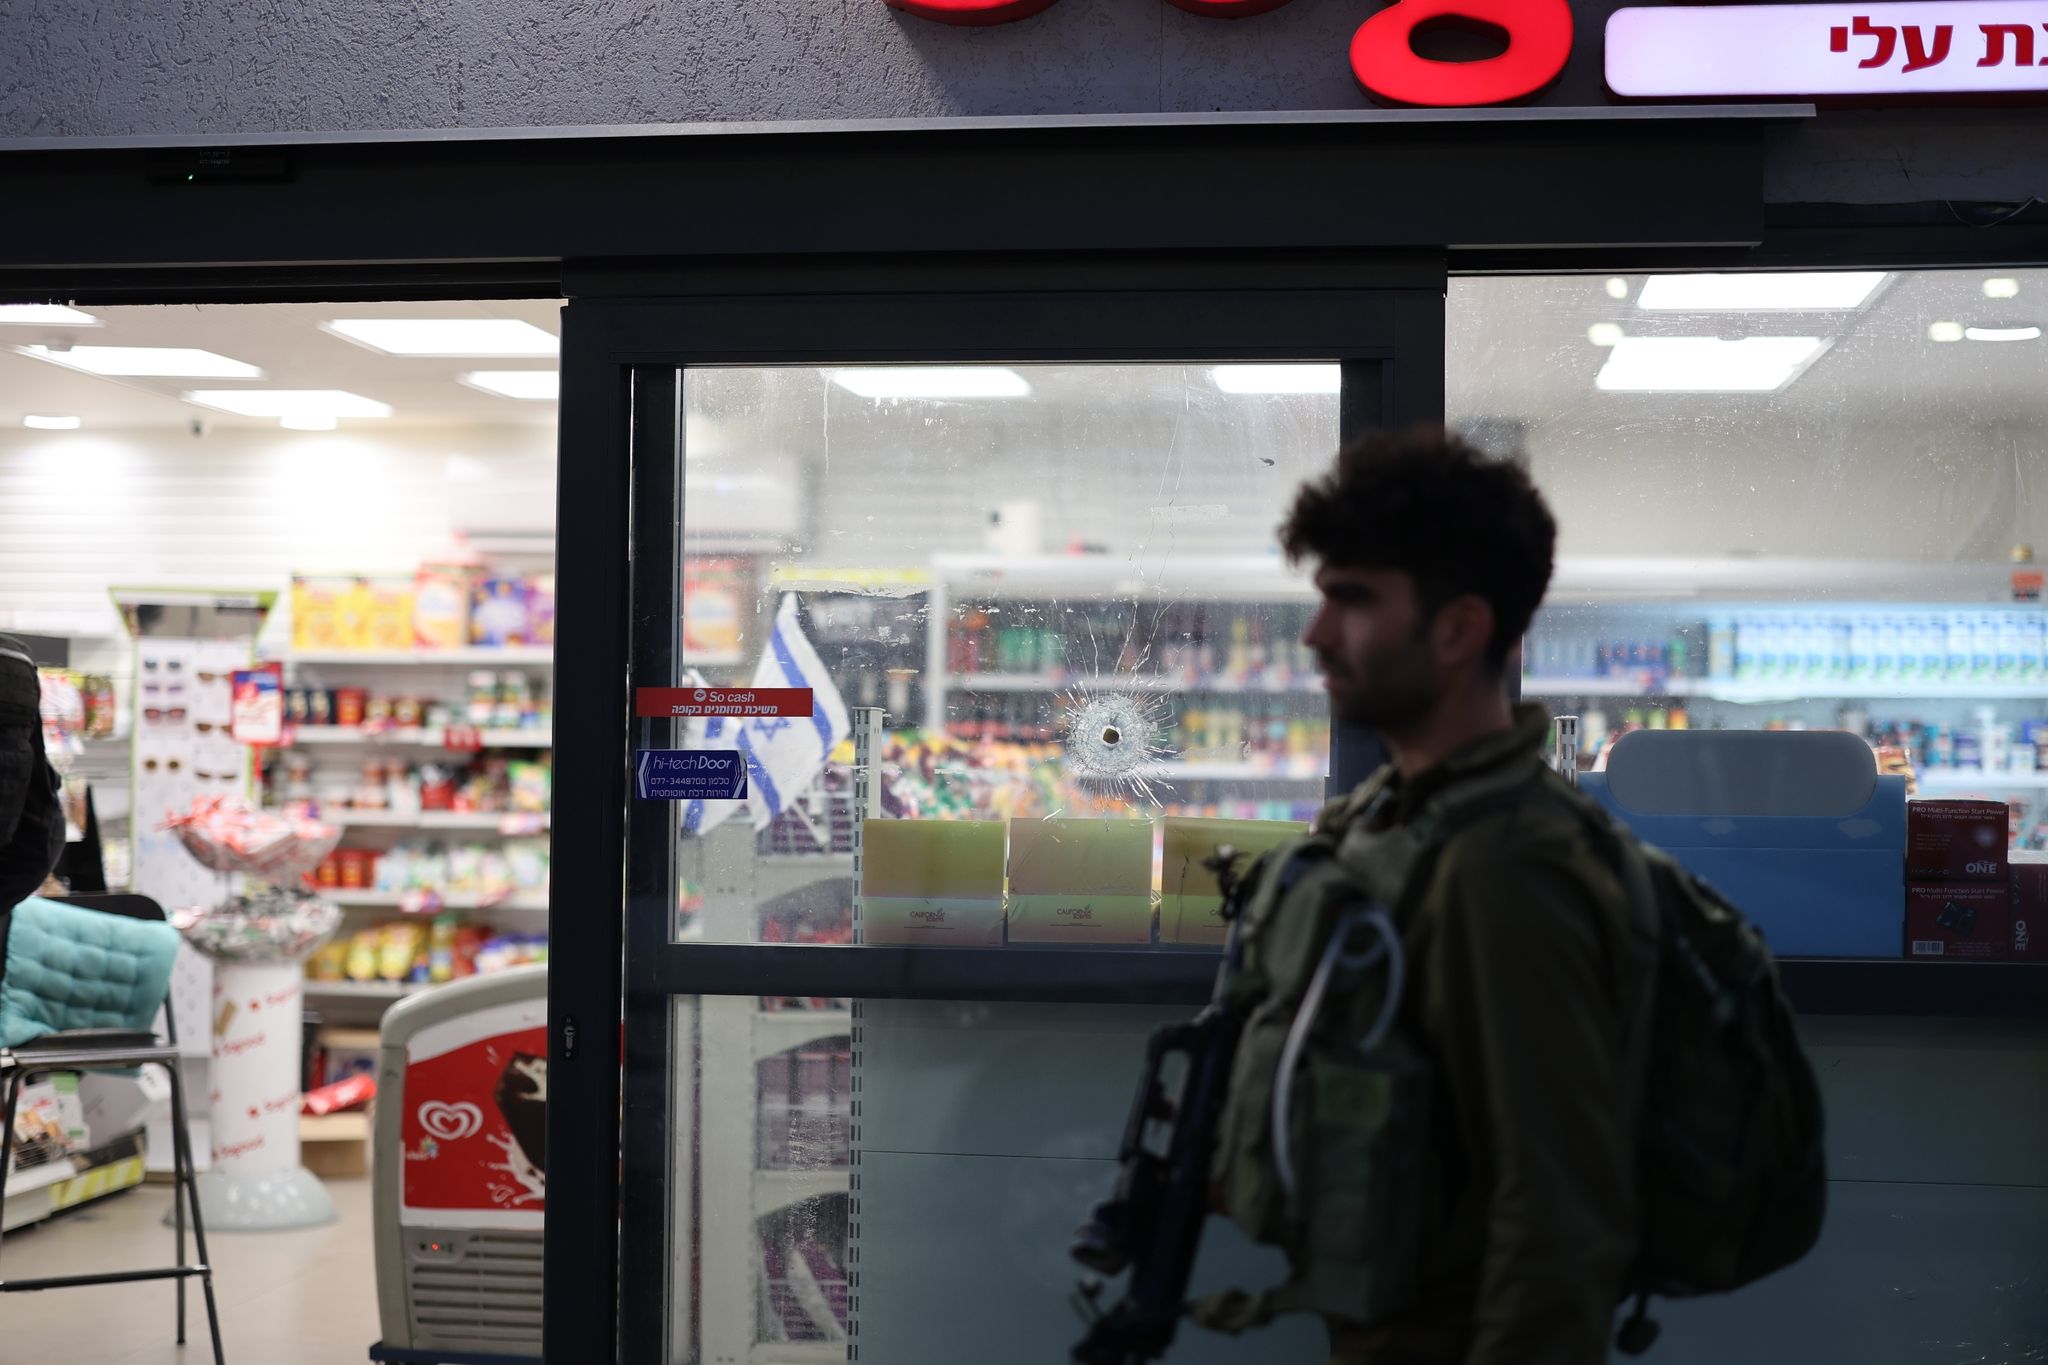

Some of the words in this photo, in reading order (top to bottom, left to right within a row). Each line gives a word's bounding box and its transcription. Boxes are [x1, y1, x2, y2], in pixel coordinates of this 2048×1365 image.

[1830, 16, 1954, 74] עלי
[709, 691, 725, 703] So
[727, 691, 755, 703] cash
[671, 705, 702, 716] בקופה
[704, 705, 742, 714] מזומנים
[744, 705, 778, 714] משיכת
[650, 777, 707, 785] 077-3448700
[708, 776, 730, 786] טלפון
[650, 789, 686, 797] אוטומטית
[688, 788, 704, 797] דלת
[706, 789, 729, 797] זהירות
[1965, 862, 1997, 875] ONE
[2015, 920, 2026, 951] ONE
